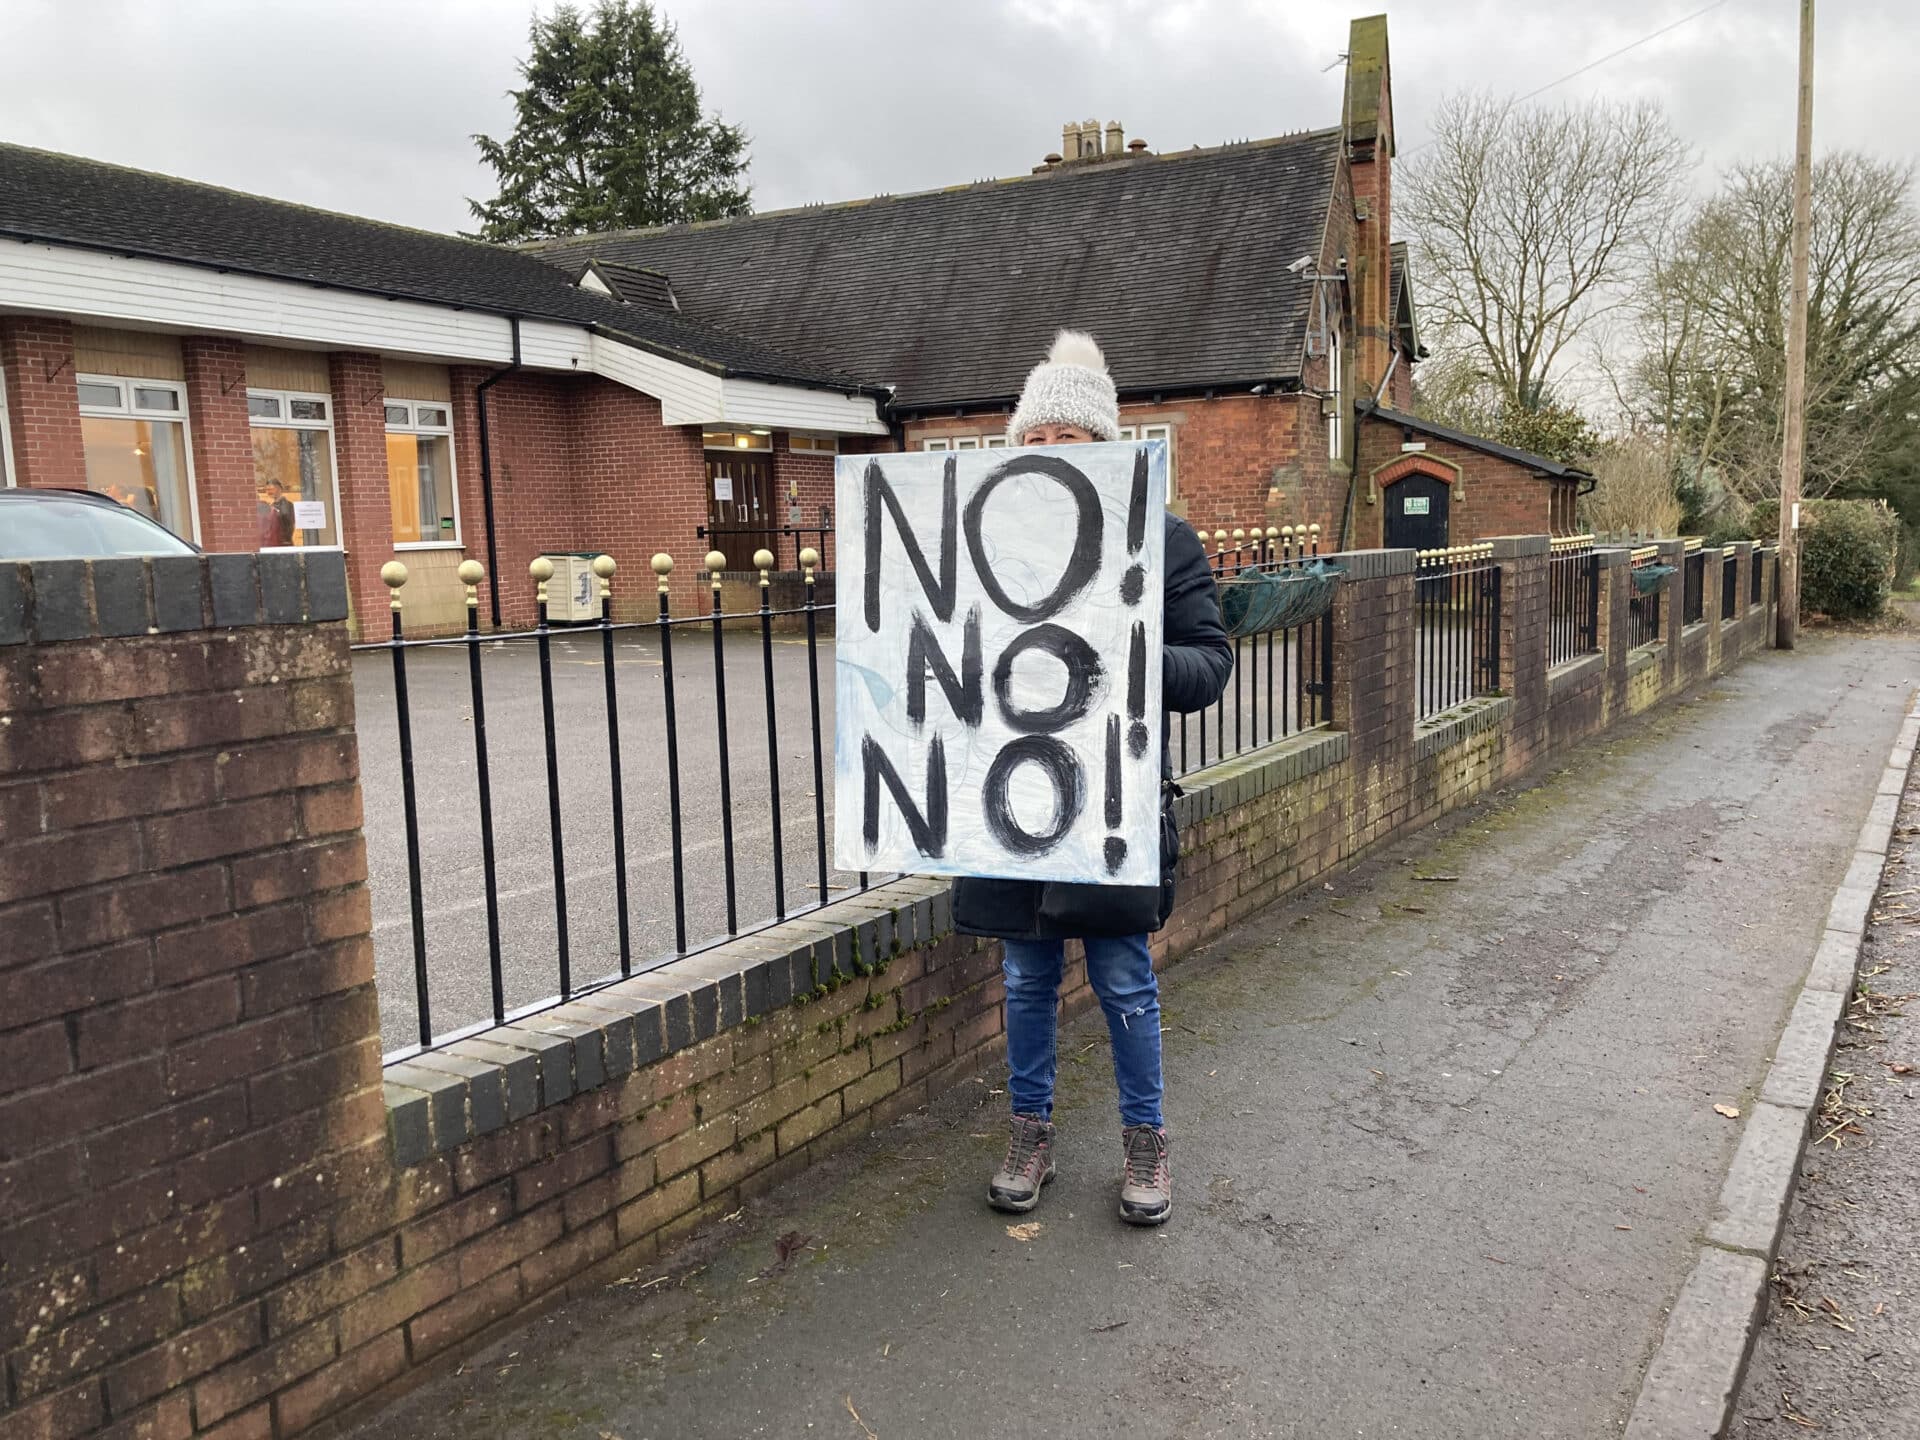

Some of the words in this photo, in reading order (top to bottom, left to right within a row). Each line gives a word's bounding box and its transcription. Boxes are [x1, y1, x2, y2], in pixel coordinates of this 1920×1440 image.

[863, 447, 1149, 633] NO!
[907, 601, 1150, 759] NO!
[862, 712, 1128, 877] NO!
